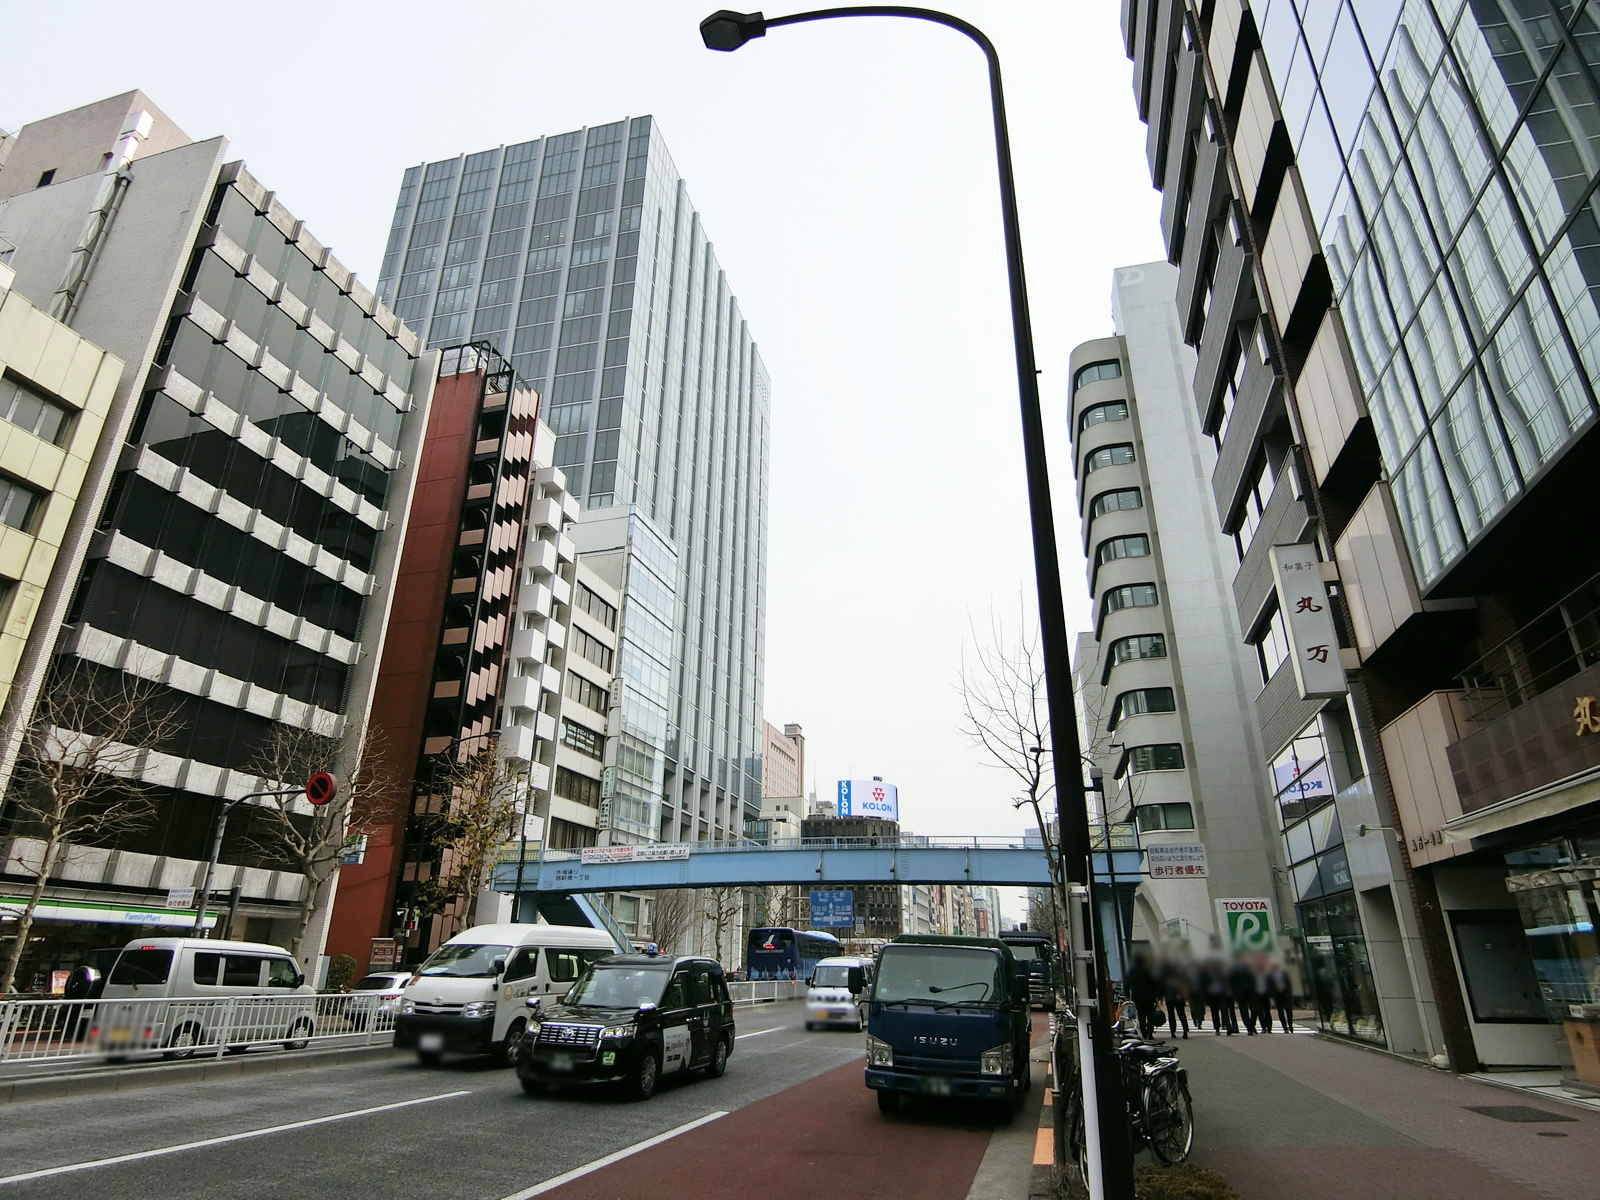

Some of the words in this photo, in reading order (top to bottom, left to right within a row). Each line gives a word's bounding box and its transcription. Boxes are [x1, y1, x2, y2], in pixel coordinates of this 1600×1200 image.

[1282, 561, 1314, 571] 和菓子
[1294, 596, 1330, 664] 丸万
[841, 781, 849, 815] KOLON
[862, 802, 892, 812] KOLON
[1154, 864, 1206, 875] 歩行者優先
[1222, 901, 1268, 911] TOYOTA
[125, 912, 162, 921] FamilyMart
[913, 1035, 958, 1046] ISUZU
